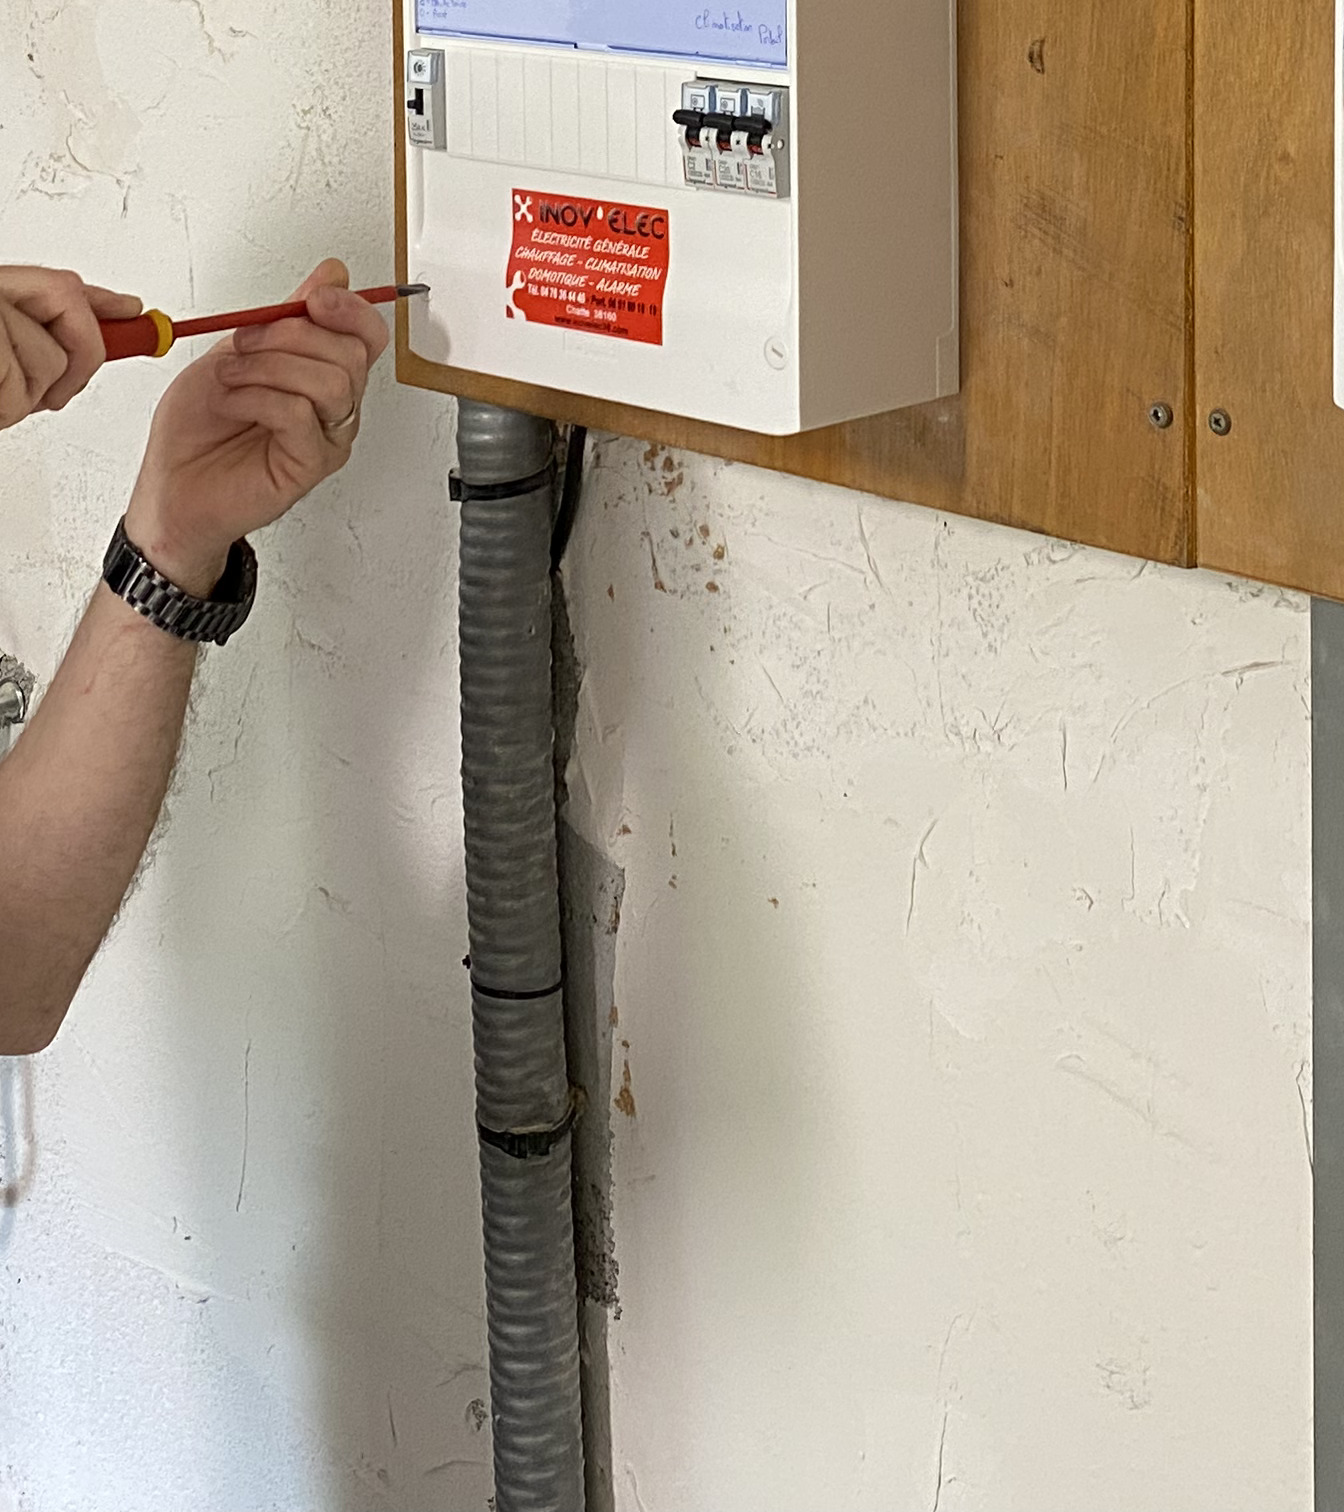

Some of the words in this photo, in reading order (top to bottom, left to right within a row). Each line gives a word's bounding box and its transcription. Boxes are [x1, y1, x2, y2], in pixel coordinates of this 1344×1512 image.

[608, 208, 665, 240] ELEC
[530, 228, 593, 250] ÉLECTRICITÉ
[593, 238, 650, 260] GÉNÉRALE
[515, 246, 577, 266] CHAUFFAGE
[584, 258, 662, 280] CLIMATISATION
[528, 268, 590, 288] DOMOTIQUE
[596, 278, 641, 296] ALARME
